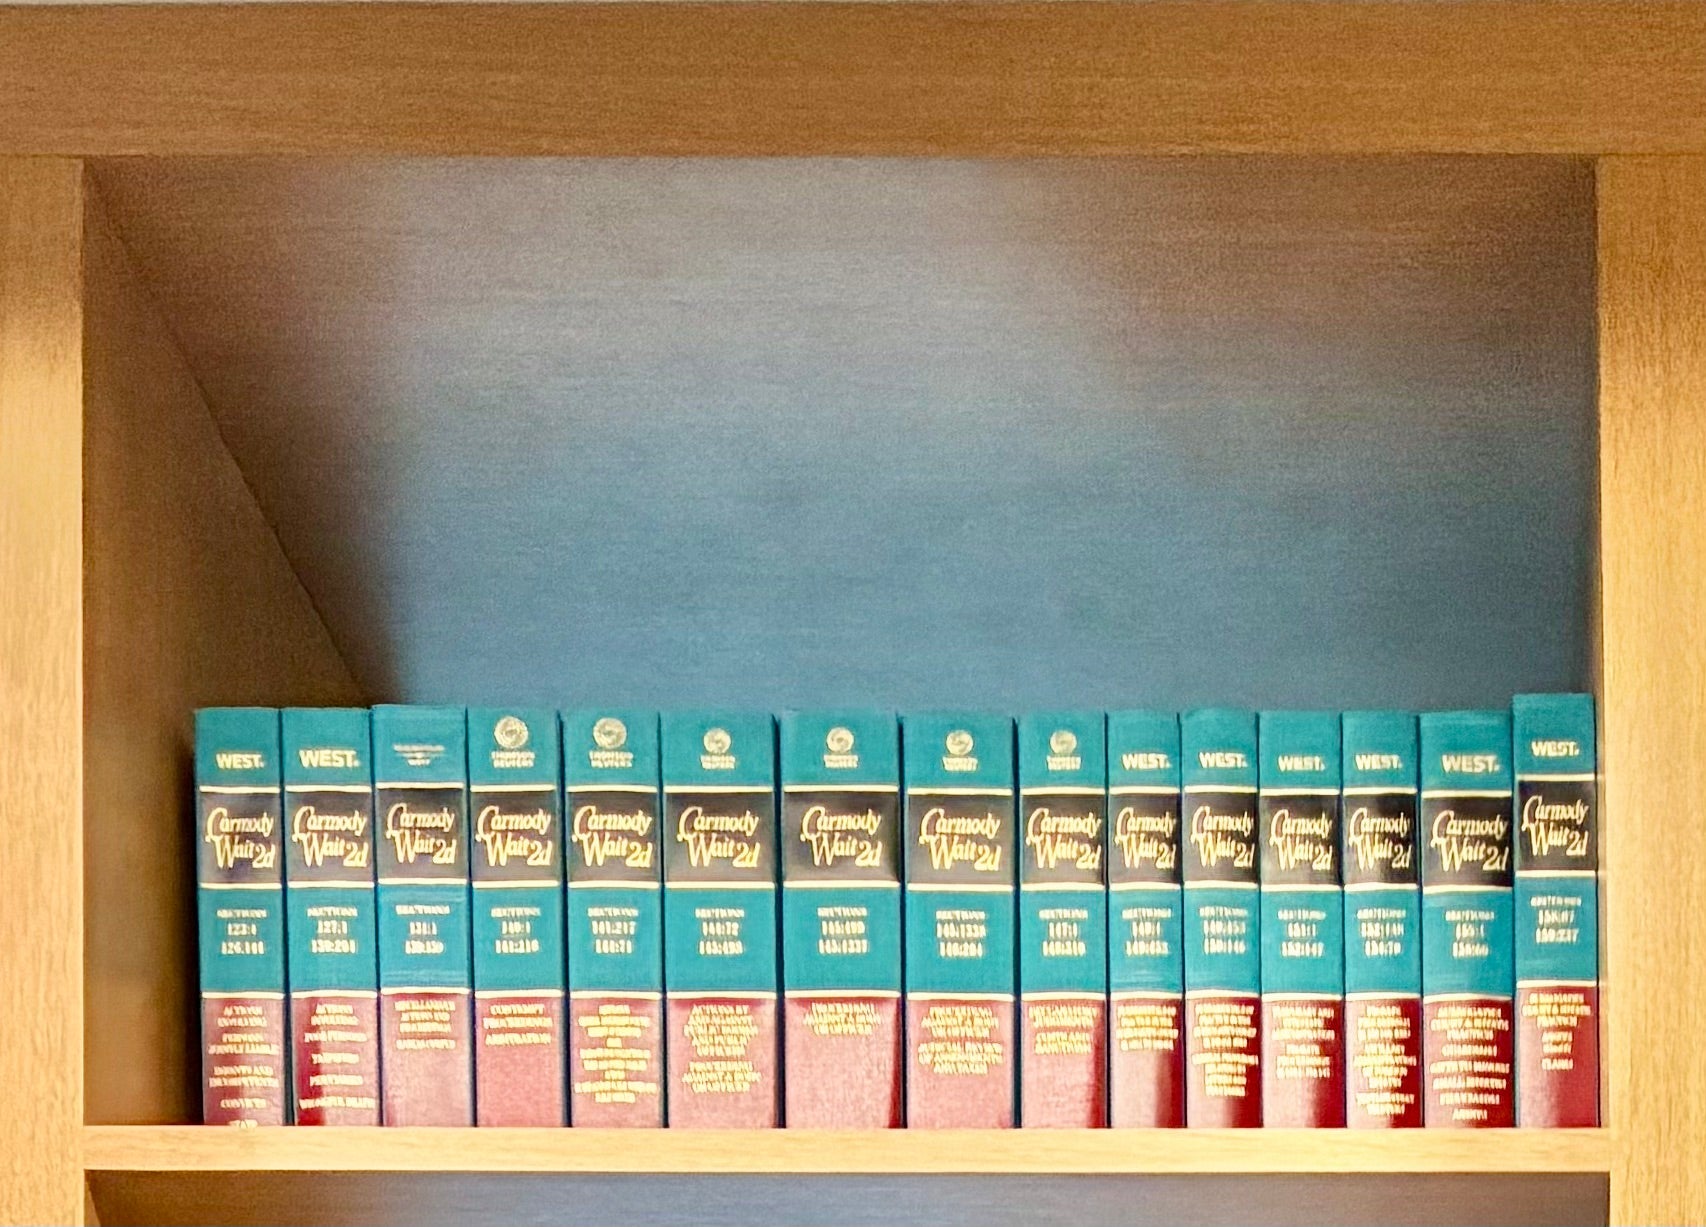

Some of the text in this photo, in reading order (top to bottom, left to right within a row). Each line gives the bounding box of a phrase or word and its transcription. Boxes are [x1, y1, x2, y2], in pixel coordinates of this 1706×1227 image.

[205, 807, 274, 841] Carmody
[292, 805, 366, 840] Carmody
[386, 803, 455, 837] Carmody
[476, 805, 551, 839] Carmody
[572, 806, 651, 840] Carmody
[677, 806, 759, 841] Carmody
[800, 806, 881, 841] Carmody
[919, 808, 1000, 843] Carmody
[1026, 808, 1100, 843] Carmody
[1115, 807, 1175, 842] Carmody
[1190, 806, 1253, 840] Carmody
[1270, 808, 1332, 843] Carmody
[1349, 808, 1410, 842] Carmody
[1431, 810, 1507, 844] Carmody
[1522, 795, 1587, 829] Carmody
